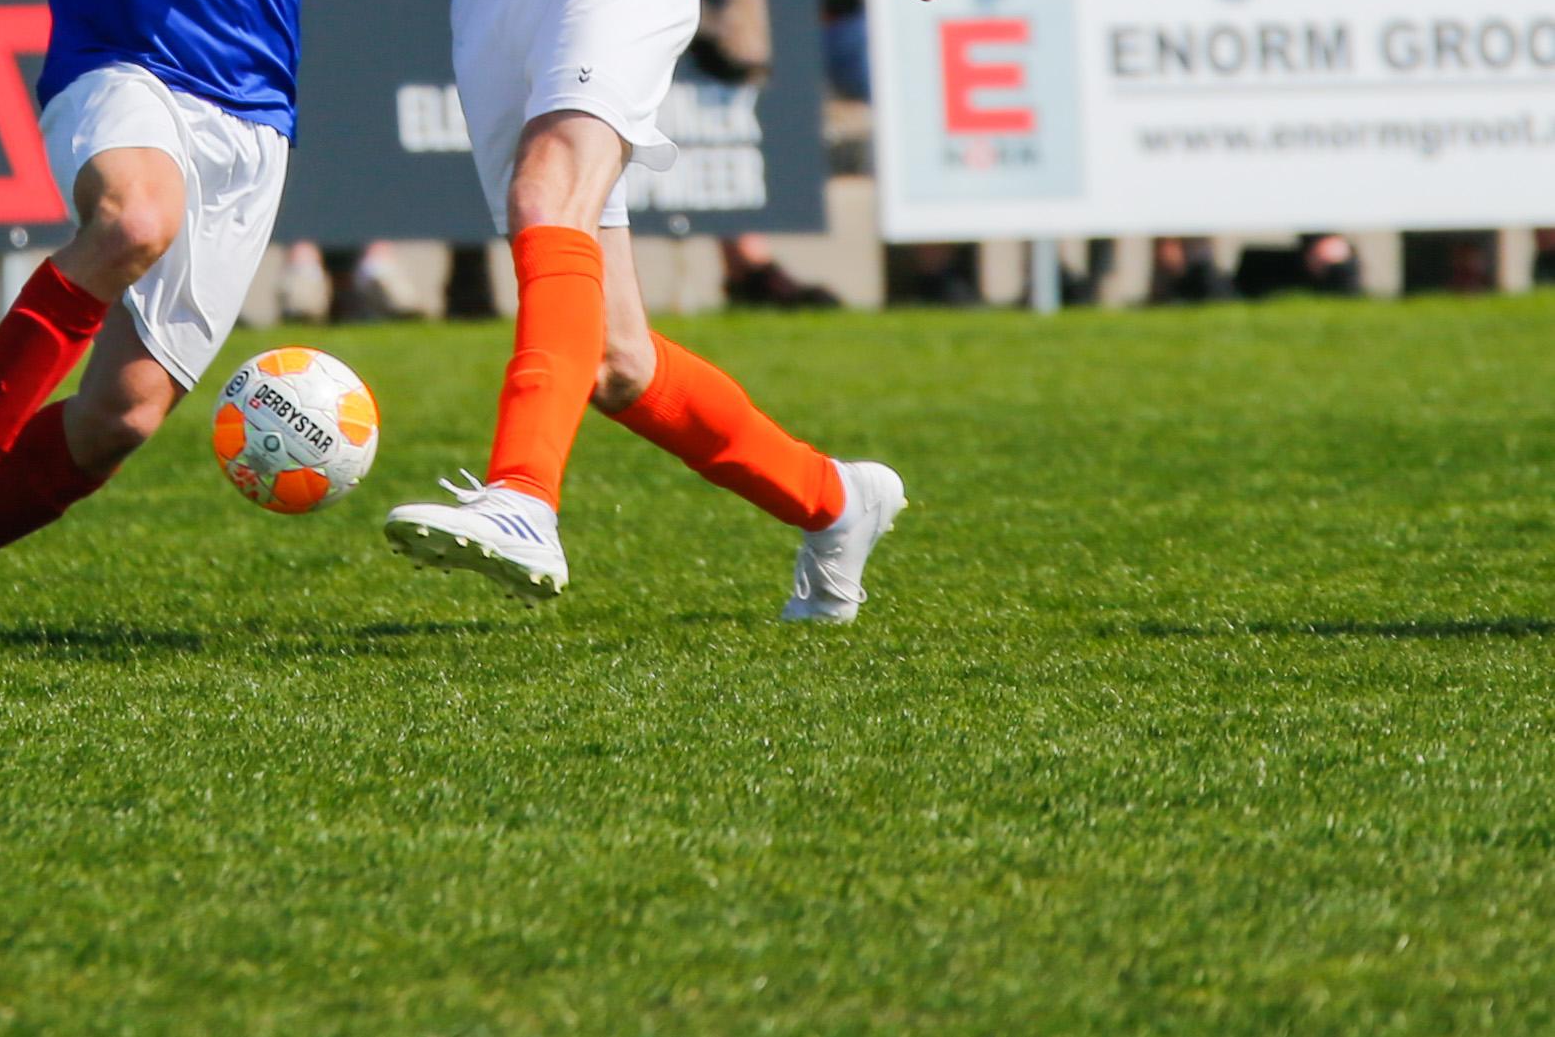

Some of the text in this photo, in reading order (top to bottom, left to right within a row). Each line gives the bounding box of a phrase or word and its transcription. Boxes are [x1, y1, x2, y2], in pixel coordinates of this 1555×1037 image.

[1108, 18, 1555, 79] ENORM GROO
[1138, 111, 1555, 158] www.enormgroot.
[254, 383, 333, 454] DERBYSTAR
